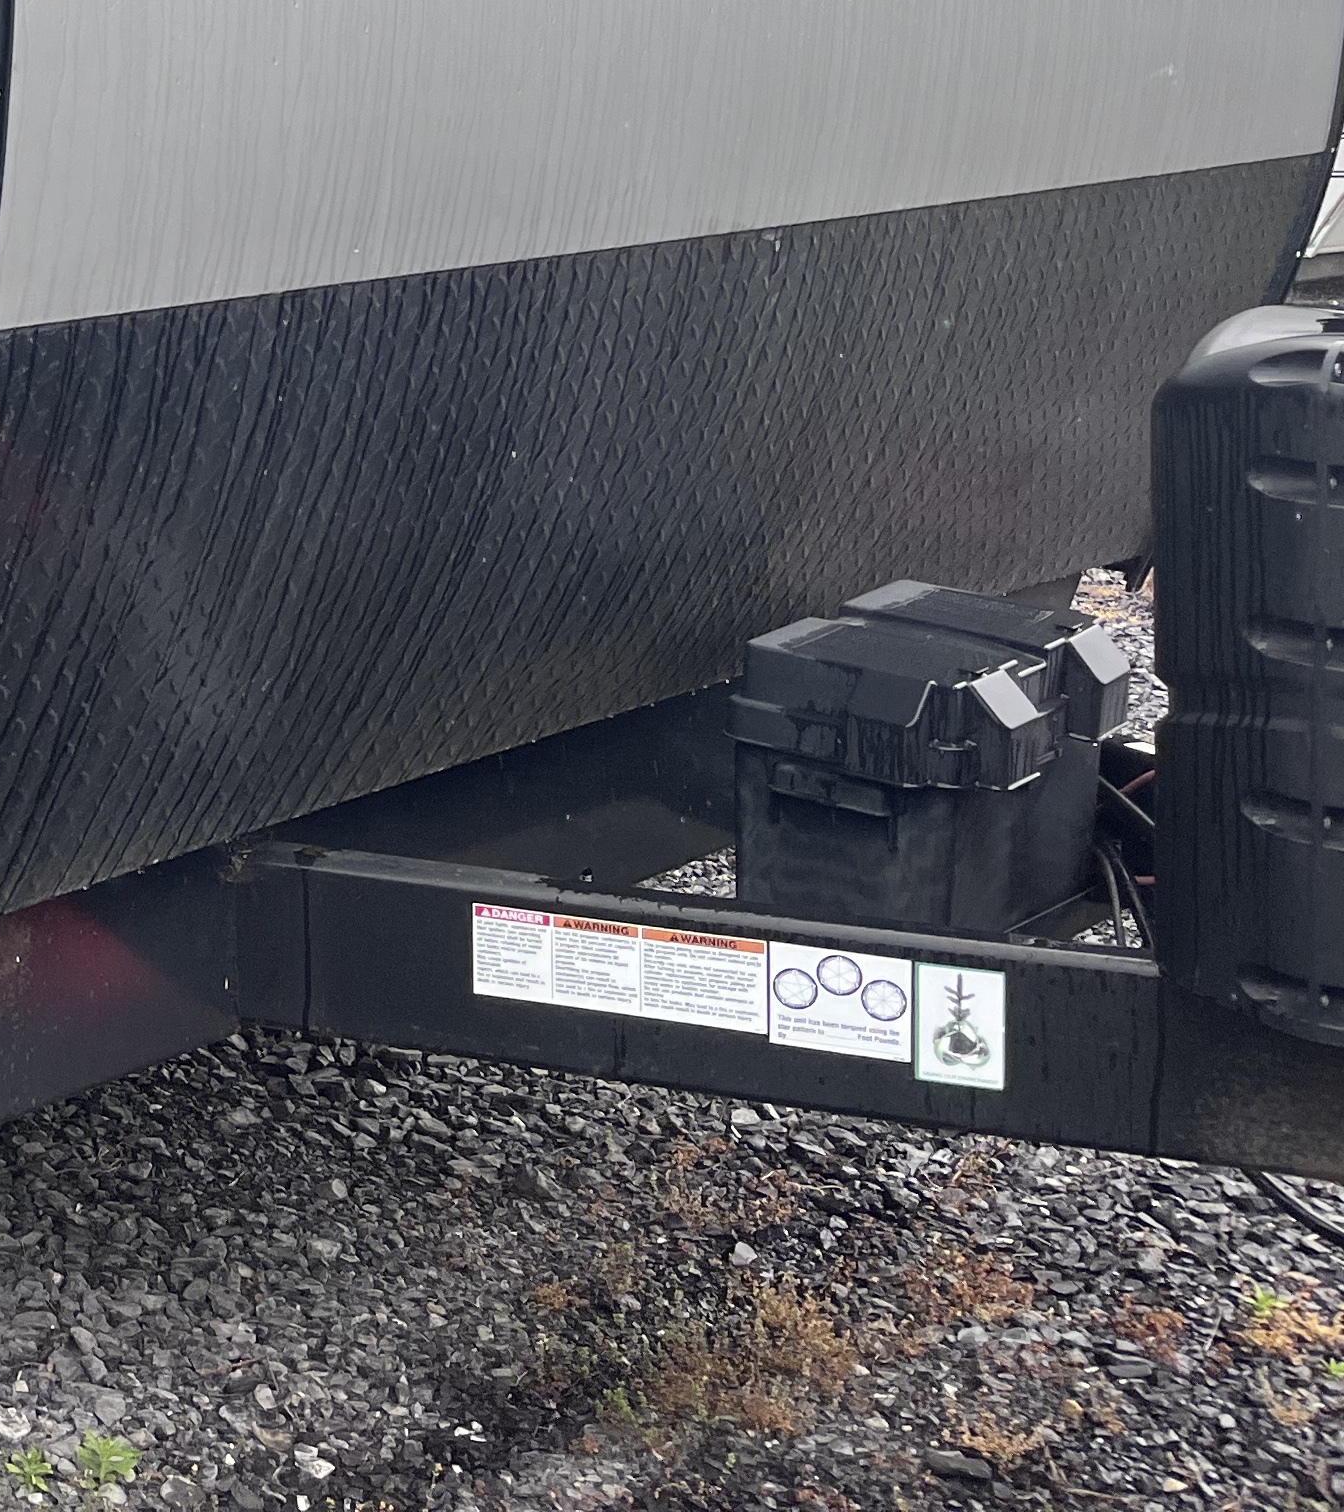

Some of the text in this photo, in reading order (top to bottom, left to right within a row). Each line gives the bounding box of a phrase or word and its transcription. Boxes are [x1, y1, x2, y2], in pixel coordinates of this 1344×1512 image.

[491, 908, 544, 925] DANGER
[573, 921, 630, 936] WARNING
[680, 934, 738, 949] WARNING
